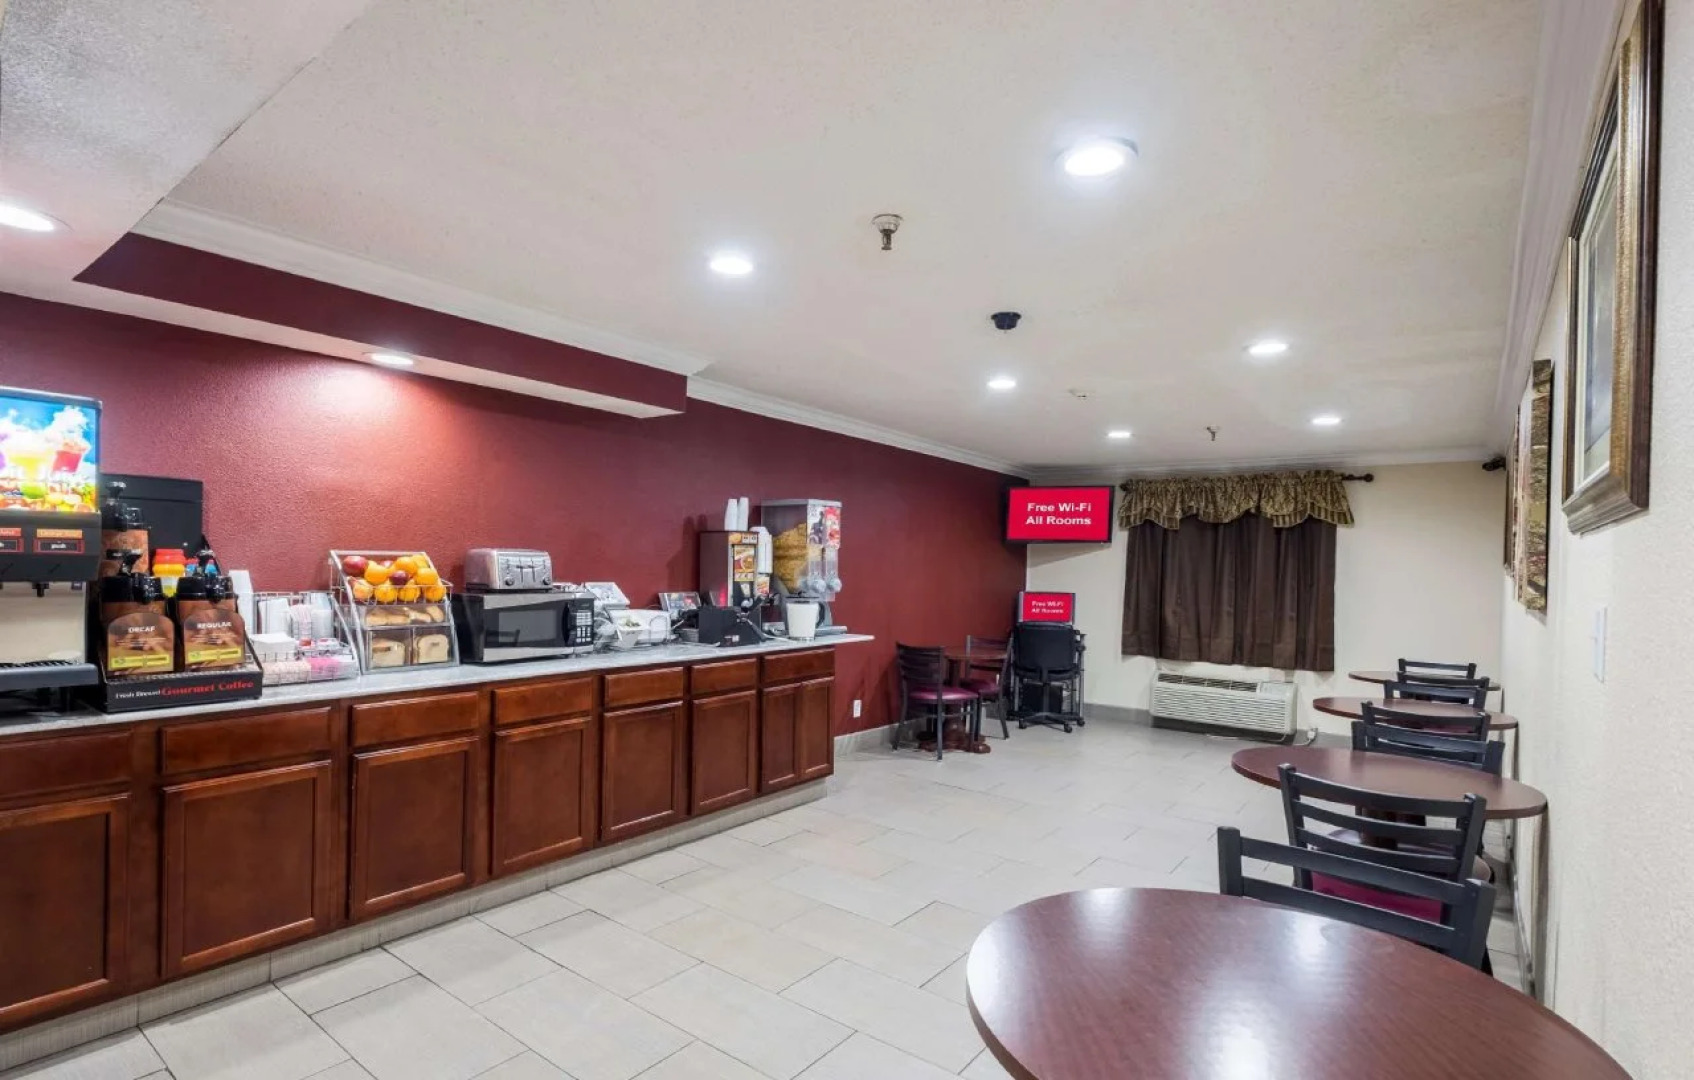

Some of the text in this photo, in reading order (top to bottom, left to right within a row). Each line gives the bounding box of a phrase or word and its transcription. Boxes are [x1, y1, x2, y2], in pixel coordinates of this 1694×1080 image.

[1027, 502, 1092, 512] Free Wi-Fi
[1026, 516, 1092, 525] All Rooms
[128, 625, 156, 634] DECAF
[197, 621, 232, 629] REGULAR
[161, 684, 215, 696] Gourmet
[218, 681, 254, 691] Coffee
